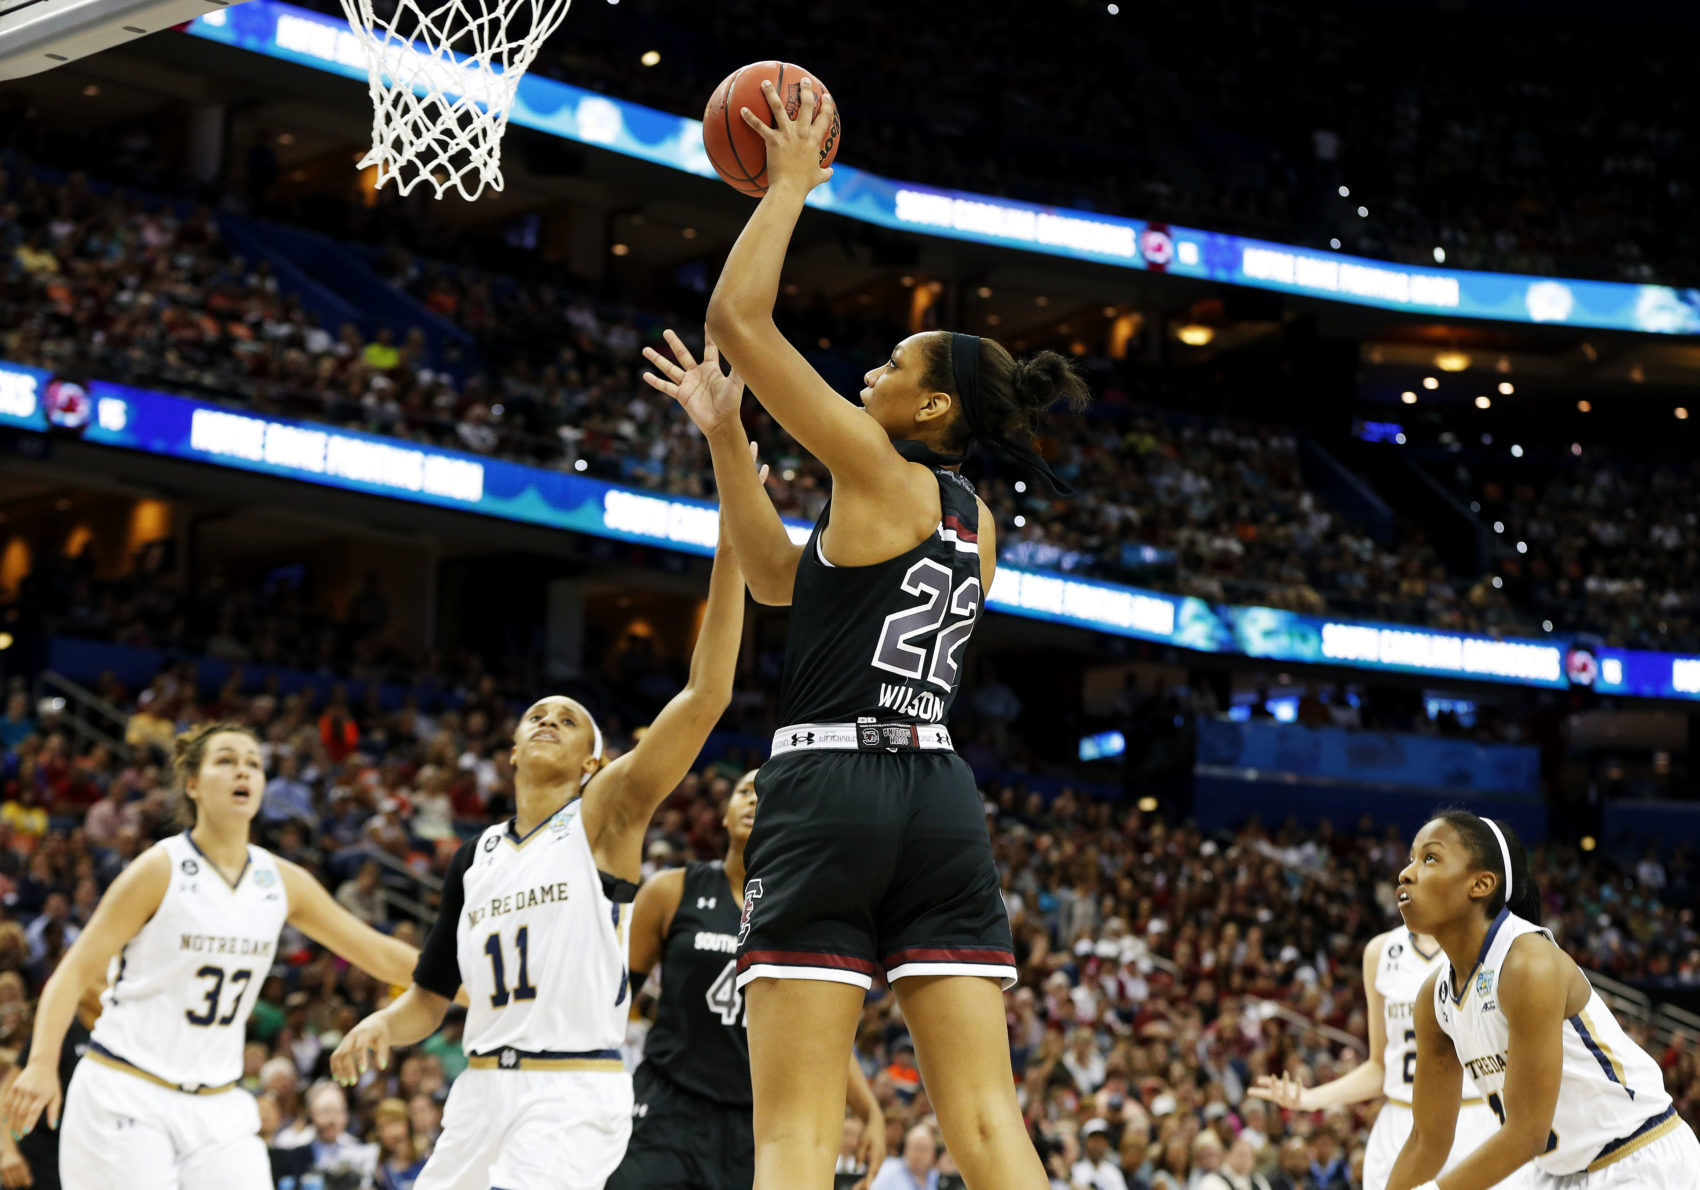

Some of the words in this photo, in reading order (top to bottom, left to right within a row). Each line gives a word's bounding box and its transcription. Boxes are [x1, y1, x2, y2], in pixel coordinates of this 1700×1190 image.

[871, 557, 980, 693] 22
[878, 683, 945, 723] WILSON
[515, 882, 569, 911] DAME
[180, 932, 236, 955] NOTRE
[694, 931, 738, 954] SOUTH
[484, 924, 537, 1011] 11
[184, 965, 252, 1027] 33
[705, 959, 747, 1028] 4
[1486, 1050, 1508, 1073] DA
